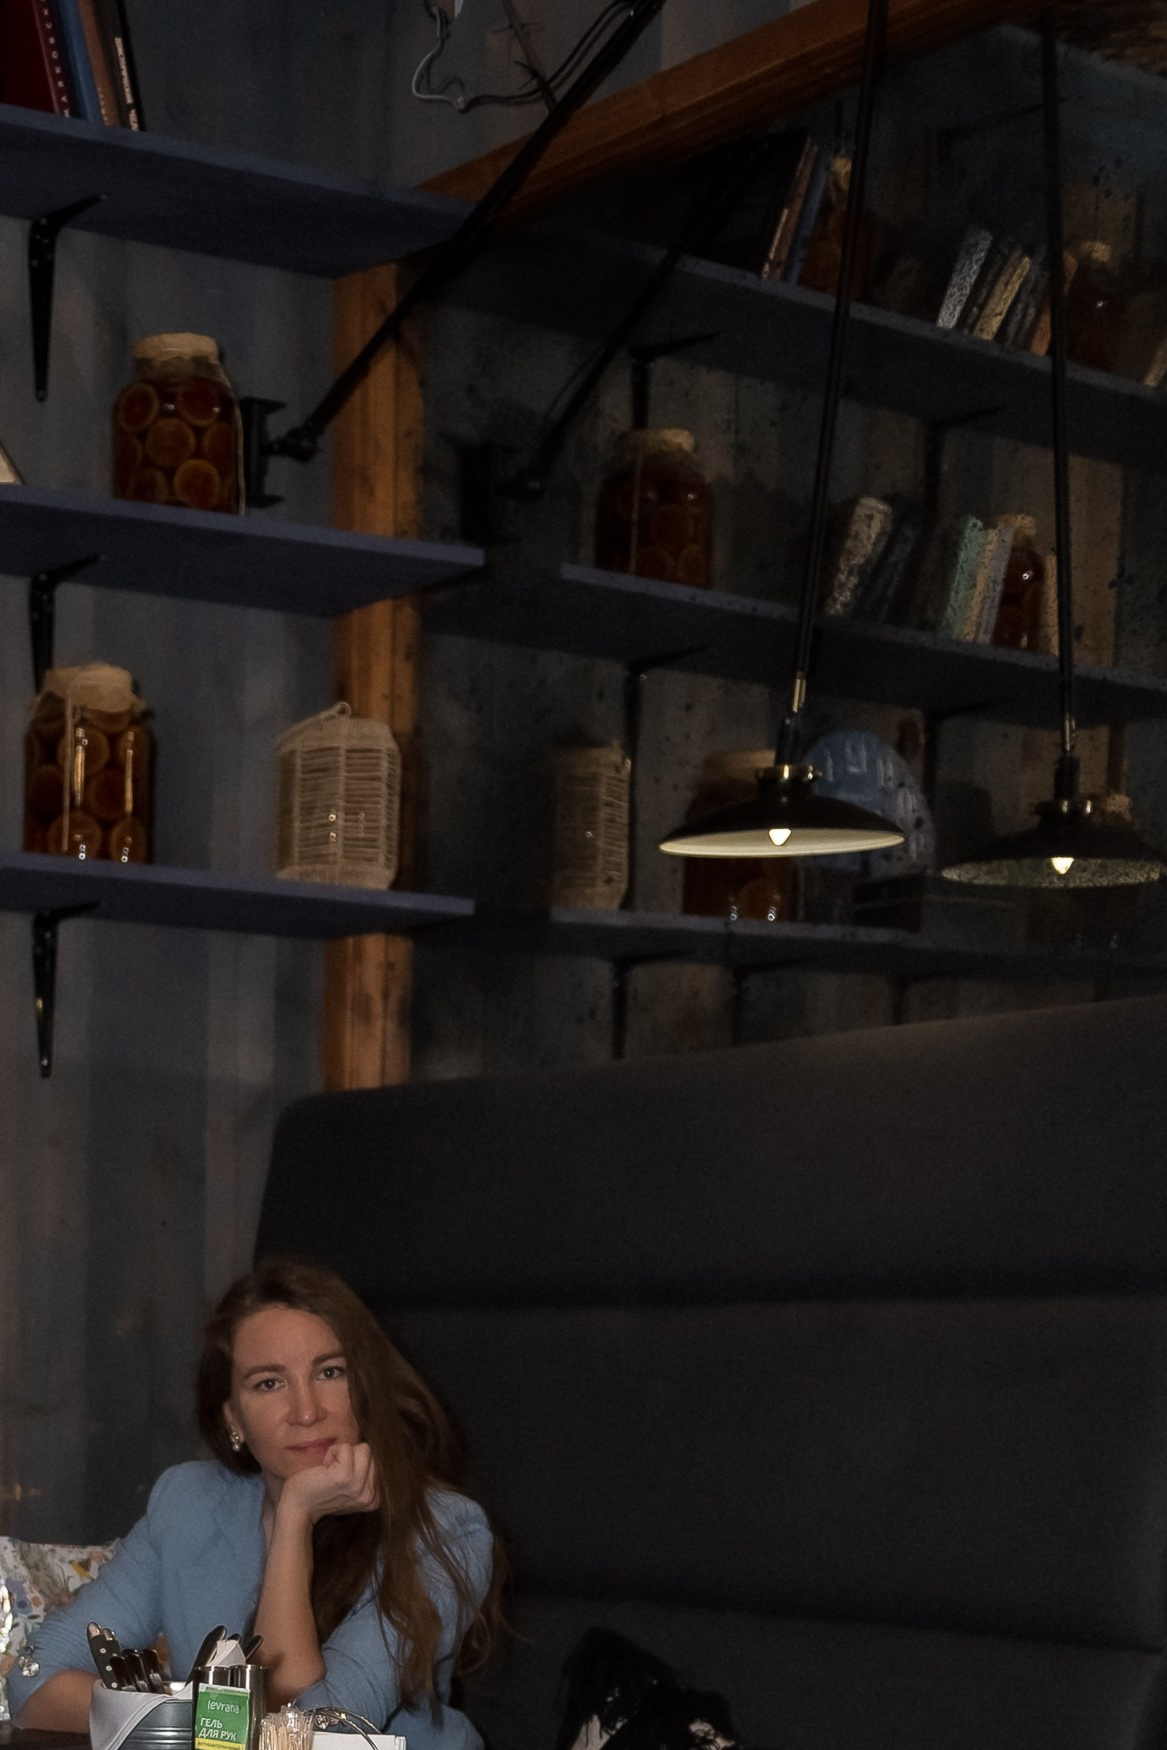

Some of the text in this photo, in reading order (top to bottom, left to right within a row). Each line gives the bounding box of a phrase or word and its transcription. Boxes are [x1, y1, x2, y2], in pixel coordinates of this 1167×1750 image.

[41, 0, 70, 118] МАЯКОВСК
[207, 1700, 240, 1714] levrana
[200, 1717, 223, 1729] ГЕЛЬ
[198, 1727, 237, 1741] ДЛЯ РУК
